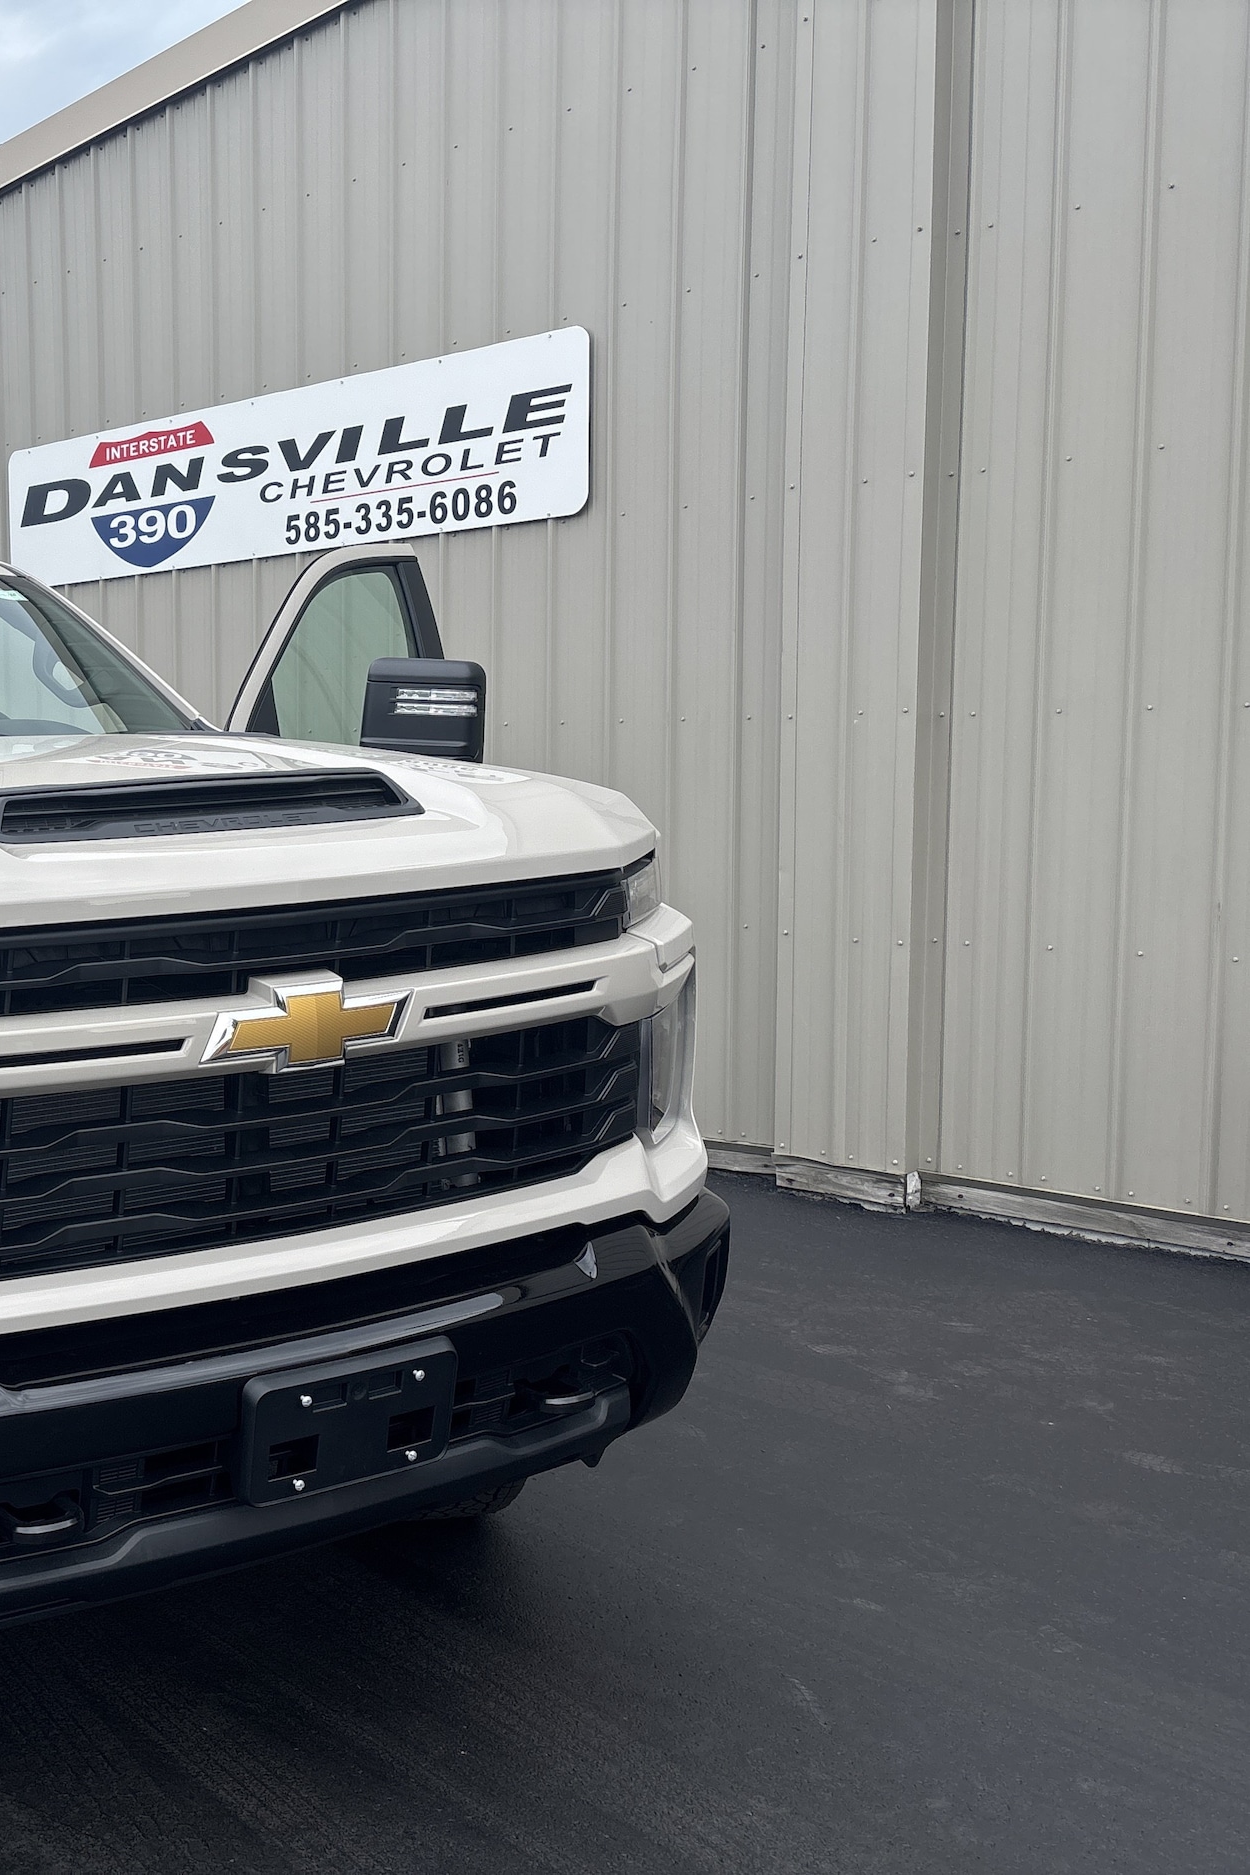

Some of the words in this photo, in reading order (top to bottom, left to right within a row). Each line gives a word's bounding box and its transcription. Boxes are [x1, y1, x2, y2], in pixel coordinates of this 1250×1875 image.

[20, 383, 573, 528] DANSVILLE
[105, 429, 196, 461] INTERSTATE
[259, 431, 562, 503] CHEVROLET
[109, 504, 197, 549] 390
[285, 480, 517, 545] 585-335-6086
[133, 811, 319, 834] CHEVROLET
